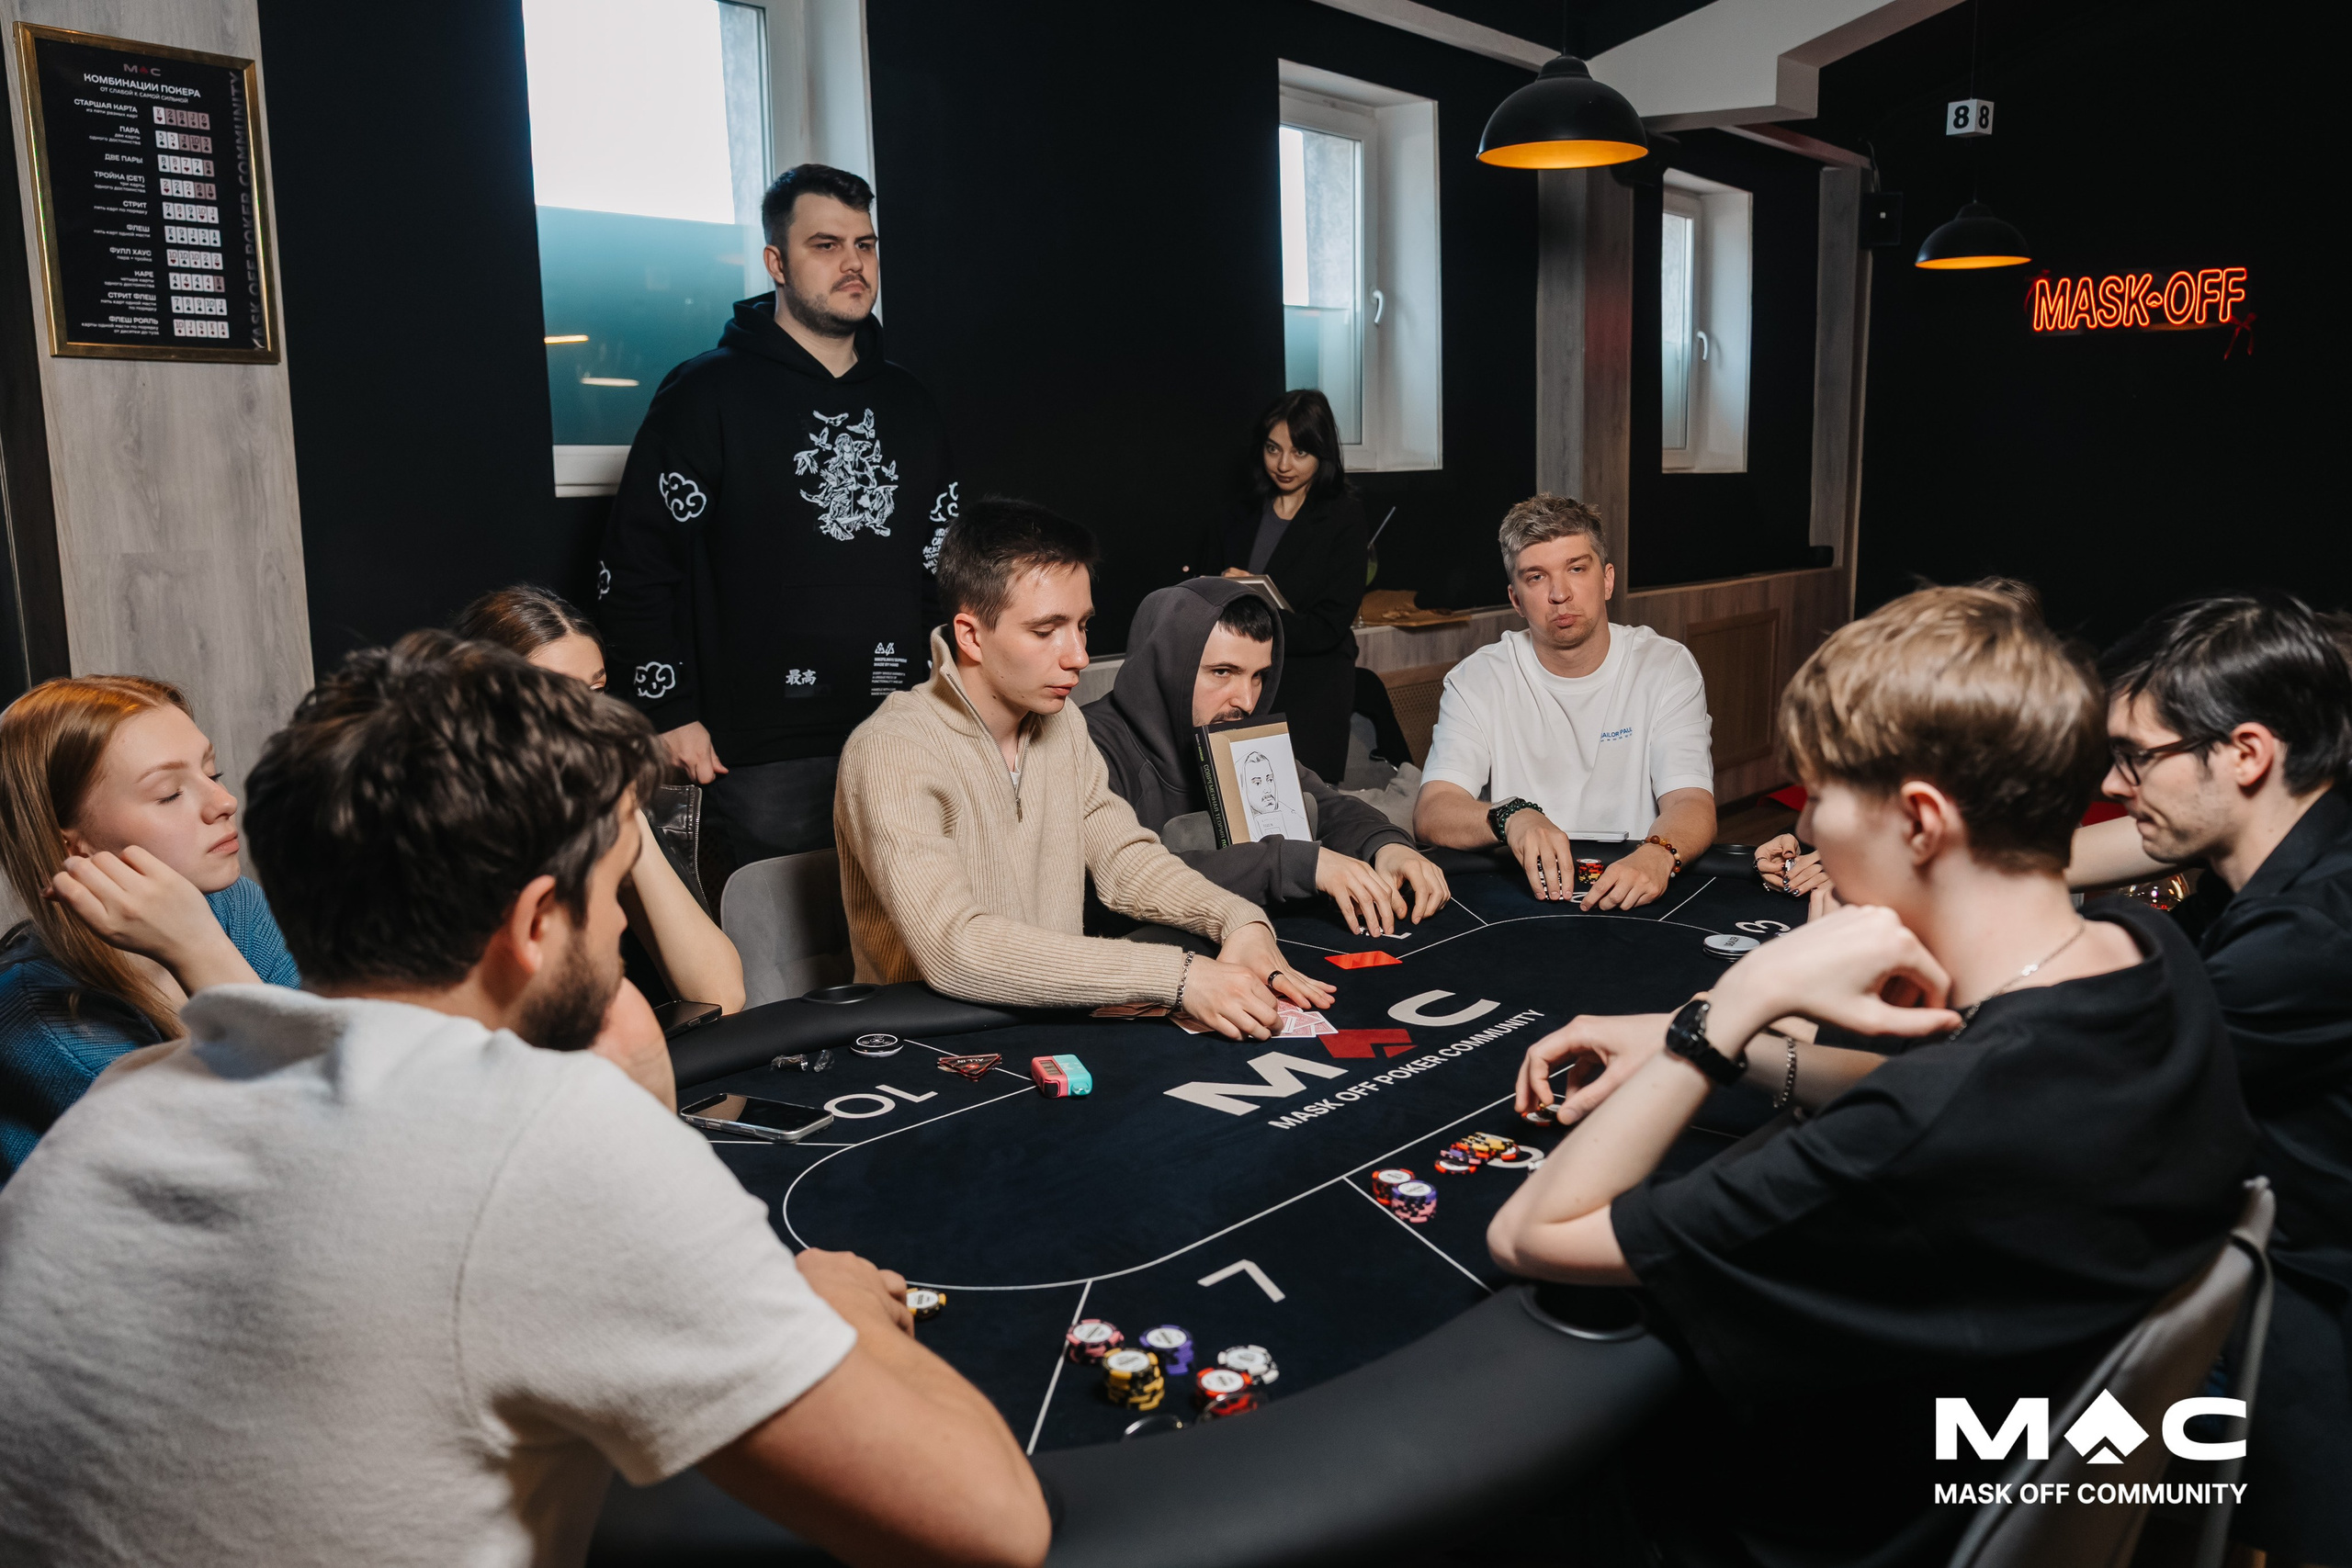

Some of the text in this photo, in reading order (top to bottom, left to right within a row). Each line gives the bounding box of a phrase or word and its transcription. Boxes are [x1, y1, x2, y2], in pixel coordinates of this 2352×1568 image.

[84, 73, 201, 98] КОМБИНАЦИИ ПОКЕРА
[74, 98, 138, 113] СТАРШАЯ КАРТА
[139, 92, 160, 100] САМОЙ
[161, 95, 189, 104] СИЛЬНОЙ
[1952, 105, 1970, 129] 8
[1978, 105, 1989, 130] 8
[119, 126, 141, 134] ПАРА
[230, 72, 250, 186] COMMUNITY
[121, 155, 143, 164] ПАРЫ
[94, 171, 145, 184] ТРОЙКА (СЕТ)
[122, 200, 147, 209] СТРИТ
[126, 224, 150, 232] ФЛЕШ
[241, 193, 255, 254] POKER
[109, 246, 130, 254] ФУЛЛ
[246, 260, 260, 296] OFF
[107, 291, 157, 301] СТРИТ ФЛЕШ
[2033, 267, 2247, 331] MASK OFF
[108, 315, 132, 323] ФЛЕШ
[786, 669, 817, 685] 最高
[1204, 764, 1219, 812] СОВРЕМЕННАЯ
[1216, 814, 1225, 839] ТЕОРИЯ
[1735, 919, 1791, 933] 3
[1268, 1009, 1545, 1129] MASK OFF POKER COMMUNITY
[1197, 1258, 1285, 1303] 7
